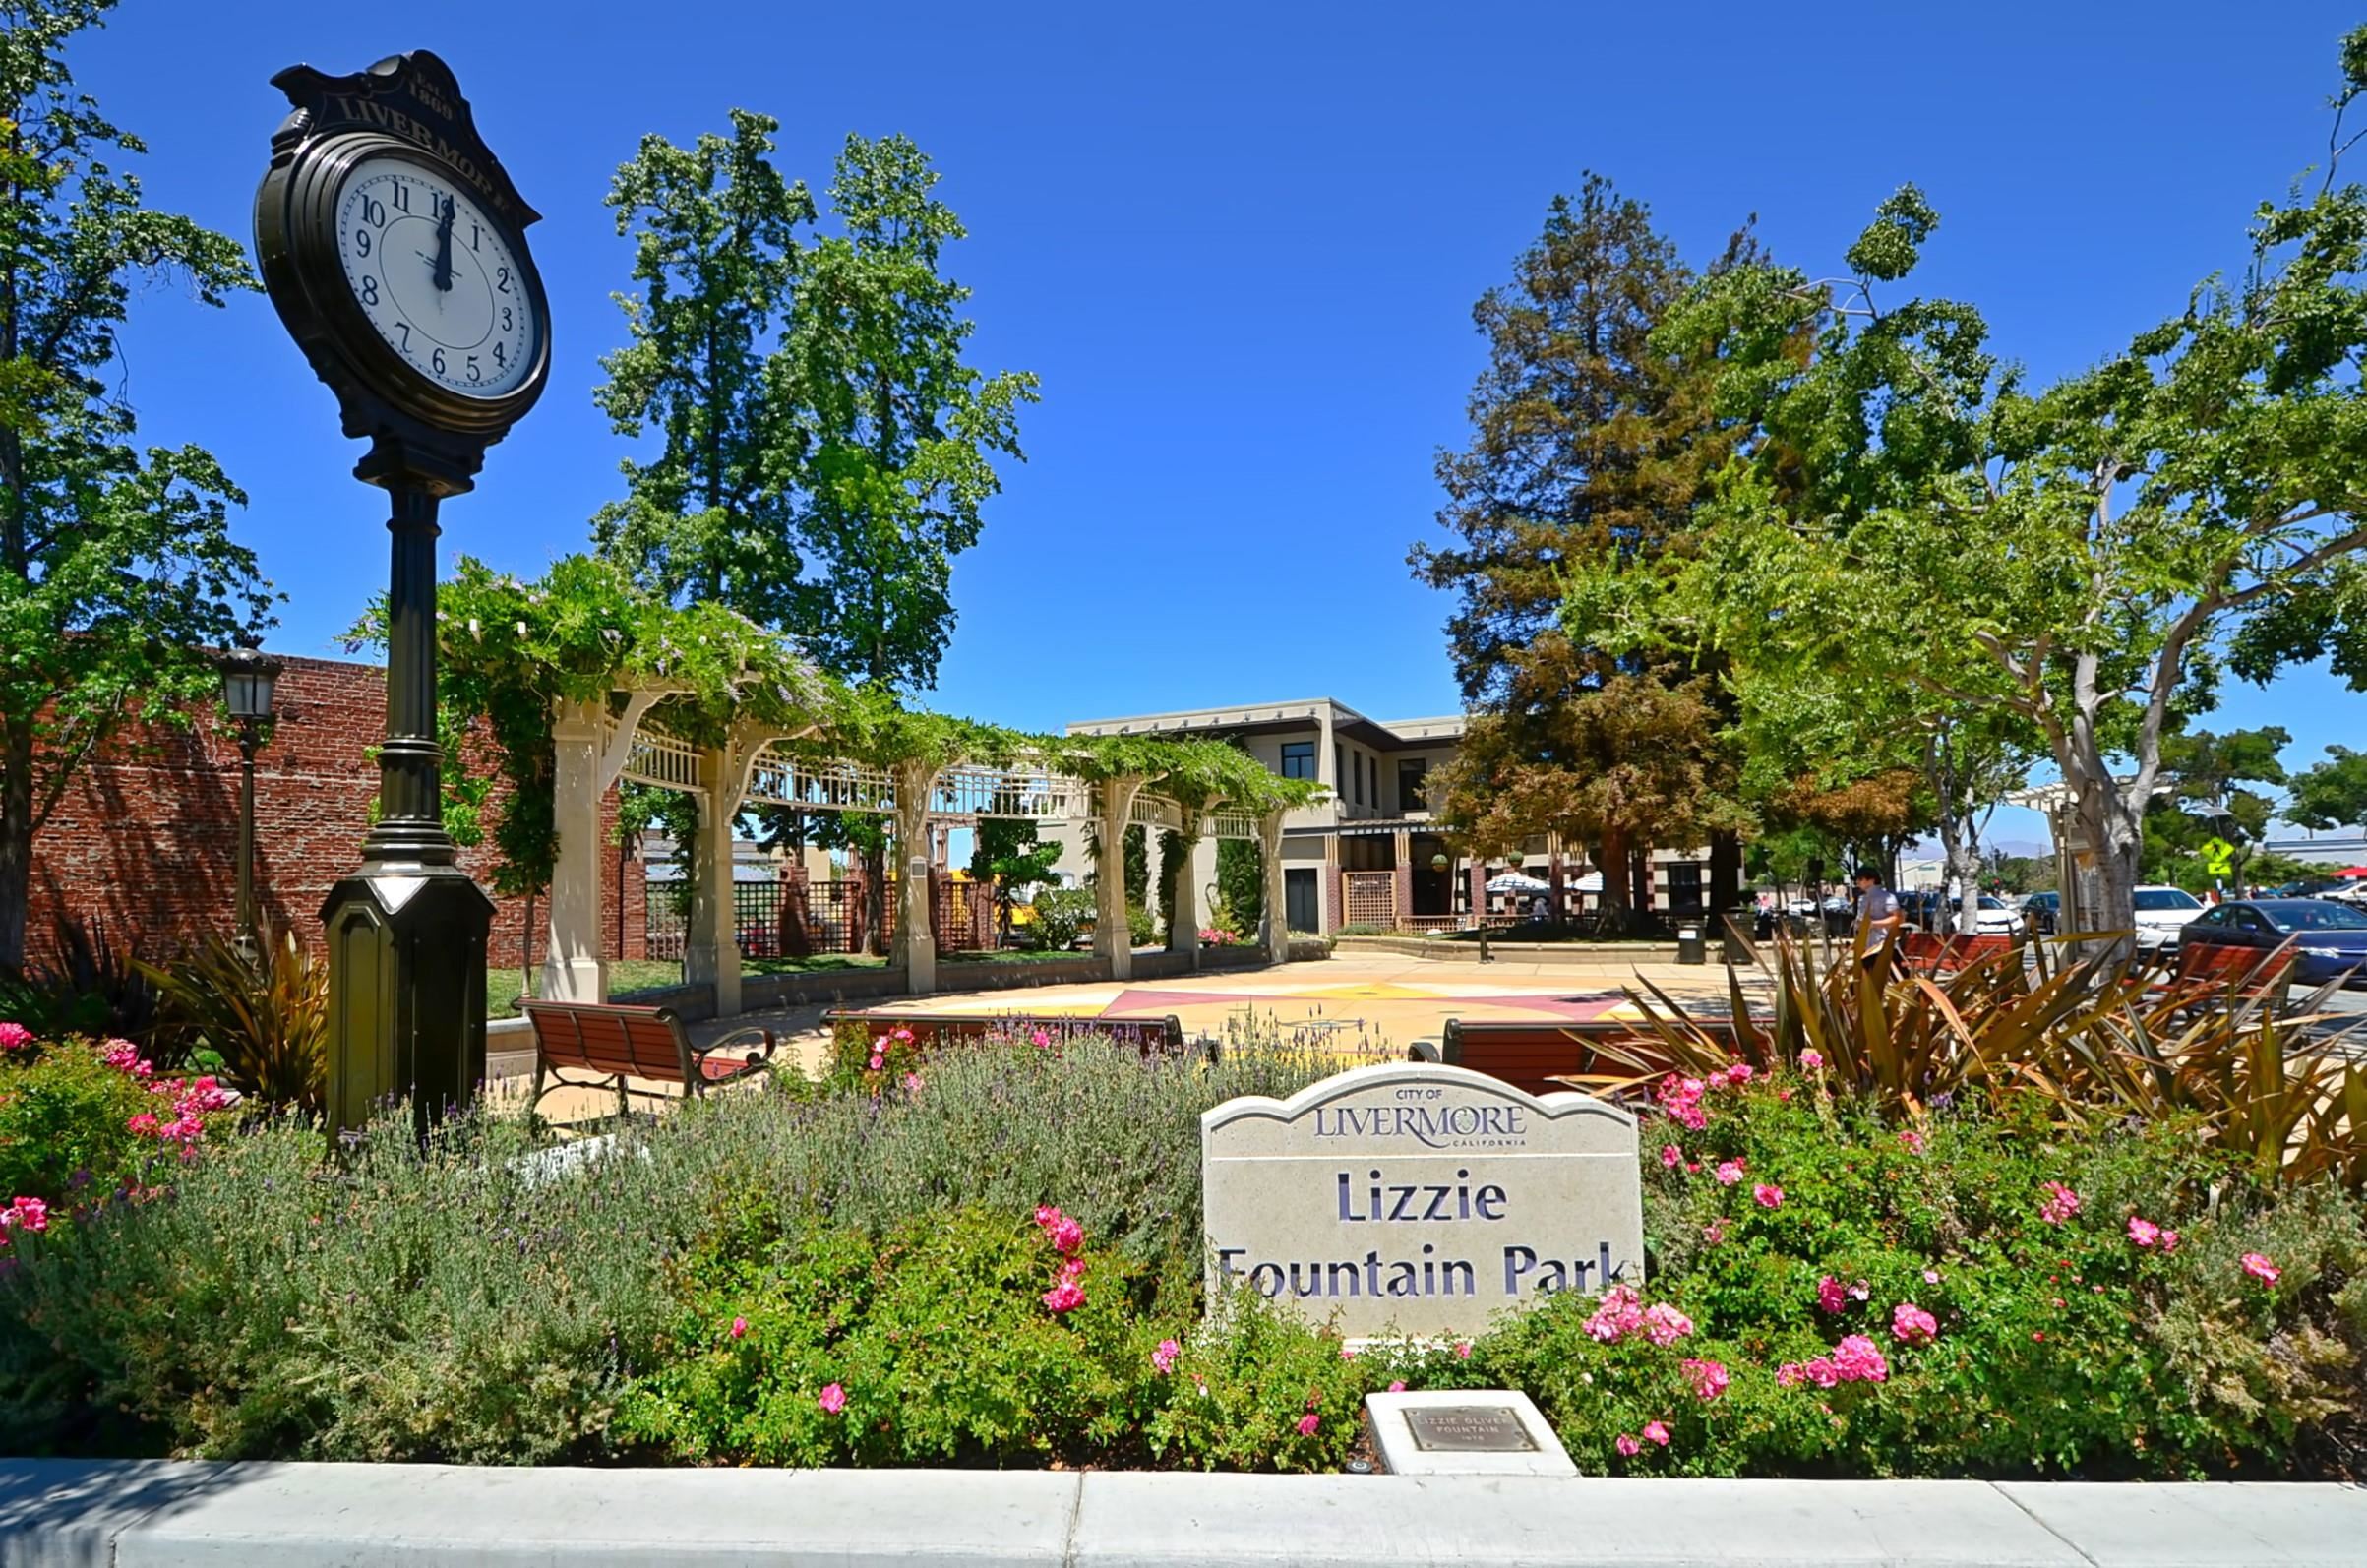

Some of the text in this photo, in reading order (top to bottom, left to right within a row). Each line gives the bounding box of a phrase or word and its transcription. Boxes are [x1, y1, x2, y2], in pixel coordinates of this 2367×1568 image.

[362, 194, 386, 228] 10
[392, 181, 411, 214] 11
[356, 228, 371, 258] 9
[471, 224, 481, 252] 1
[362, 275, 379, 306] 8
[497, 267, 510, 294] 2
[501, 306, 513, 332] 3
[394, 321, 413, 354] 7
[432, 348, 446, 375] 6
[466, 356, 481, 383] 5
[492, 341, 508, 371] 4
[1396, 1089, 1443, 1100] CITY OF
[1314, 1106, 1527, 1148] LIVERMORE
[1338, 1169, 1507, 1221] Lizzie
[1219, 1241, 1629, 1297] Fountain Park
[1418, 1417, 1458, 1425] LIZZIE
